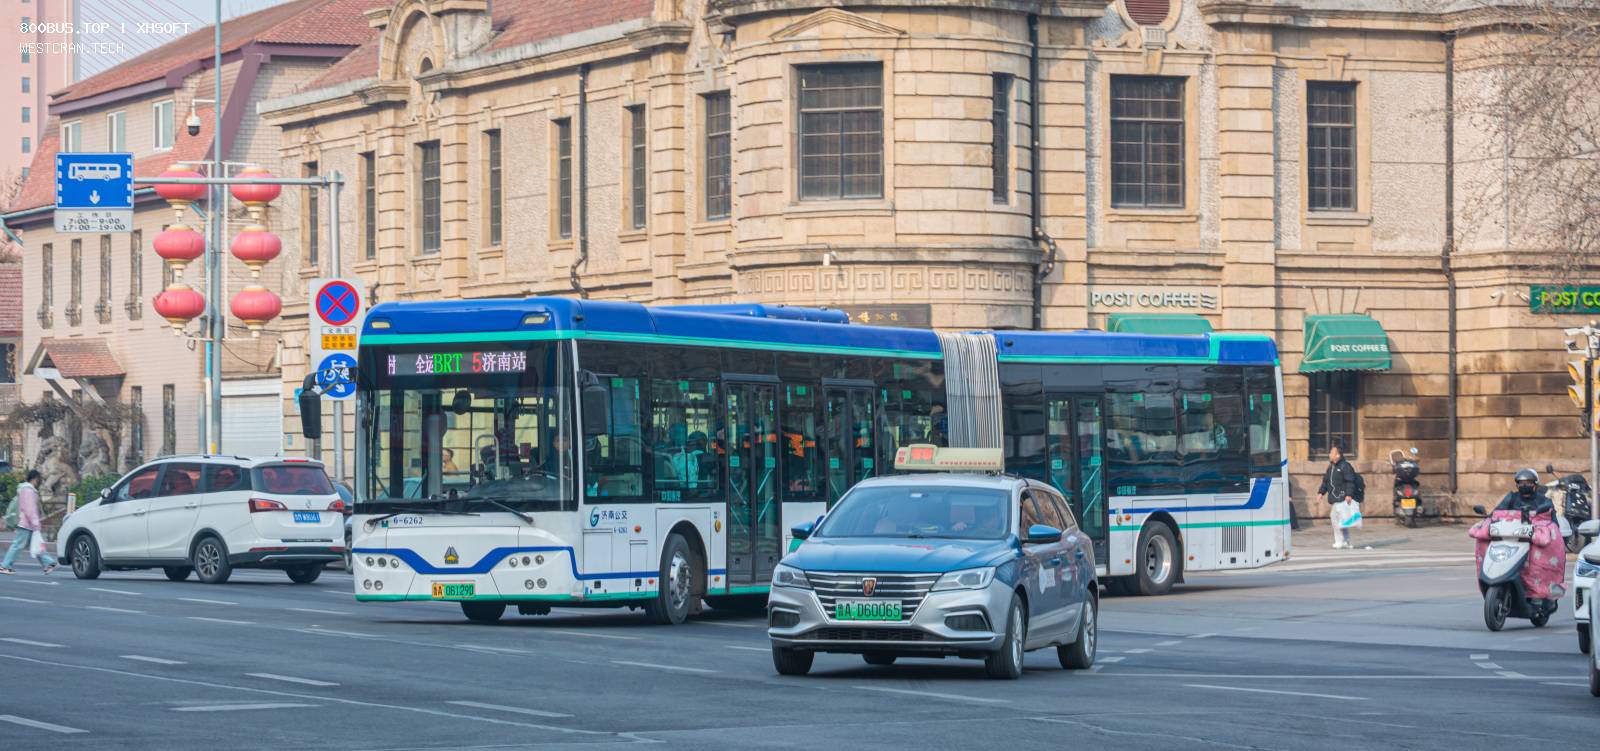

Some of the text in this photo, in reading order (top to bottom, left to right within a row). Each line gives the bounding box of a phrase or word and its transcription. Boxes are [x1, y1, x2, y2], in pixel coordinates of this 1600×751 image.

[1091, 291, 1199, 308] POST COFFEE
[1541, 291, 1578, 306] POST
[1330, 344, 1380, 352] POST COFFEE
[433, 353, 463, 374] BRT
[482, 351, 527, 372] 济南站
[393, 517, 423, 525] 6-6262
[857, 603, 900, 617] D60065
